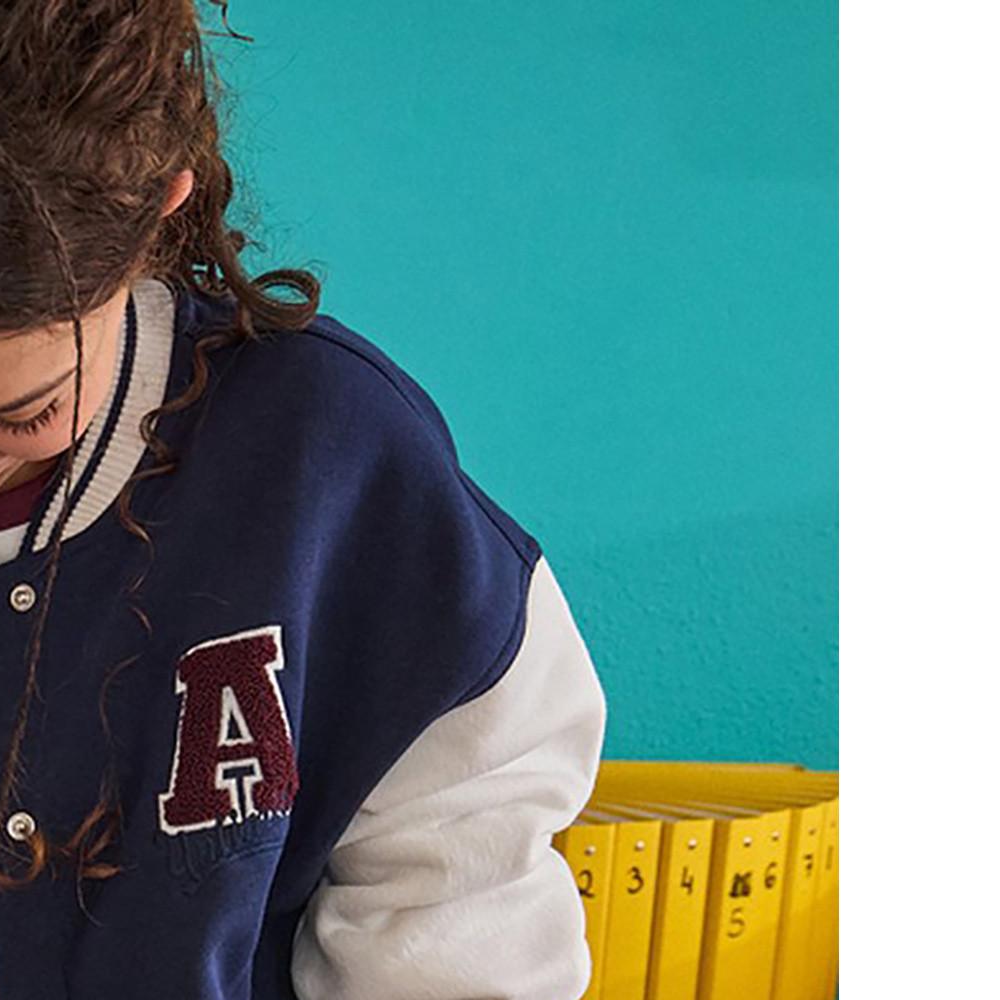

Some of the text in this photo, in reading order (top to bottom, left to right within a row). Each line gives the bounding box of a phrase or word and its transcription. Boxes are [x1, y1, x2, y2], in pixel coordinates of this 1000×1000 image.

[158, 625, 299, 836] A
[577, 869, 596, 899] 2
[626, 866, 646, 895] 3
[680, 866, 696, 896] 4
[763, 861, 778, 890] 6
[726, 906, 747, 939] 5
